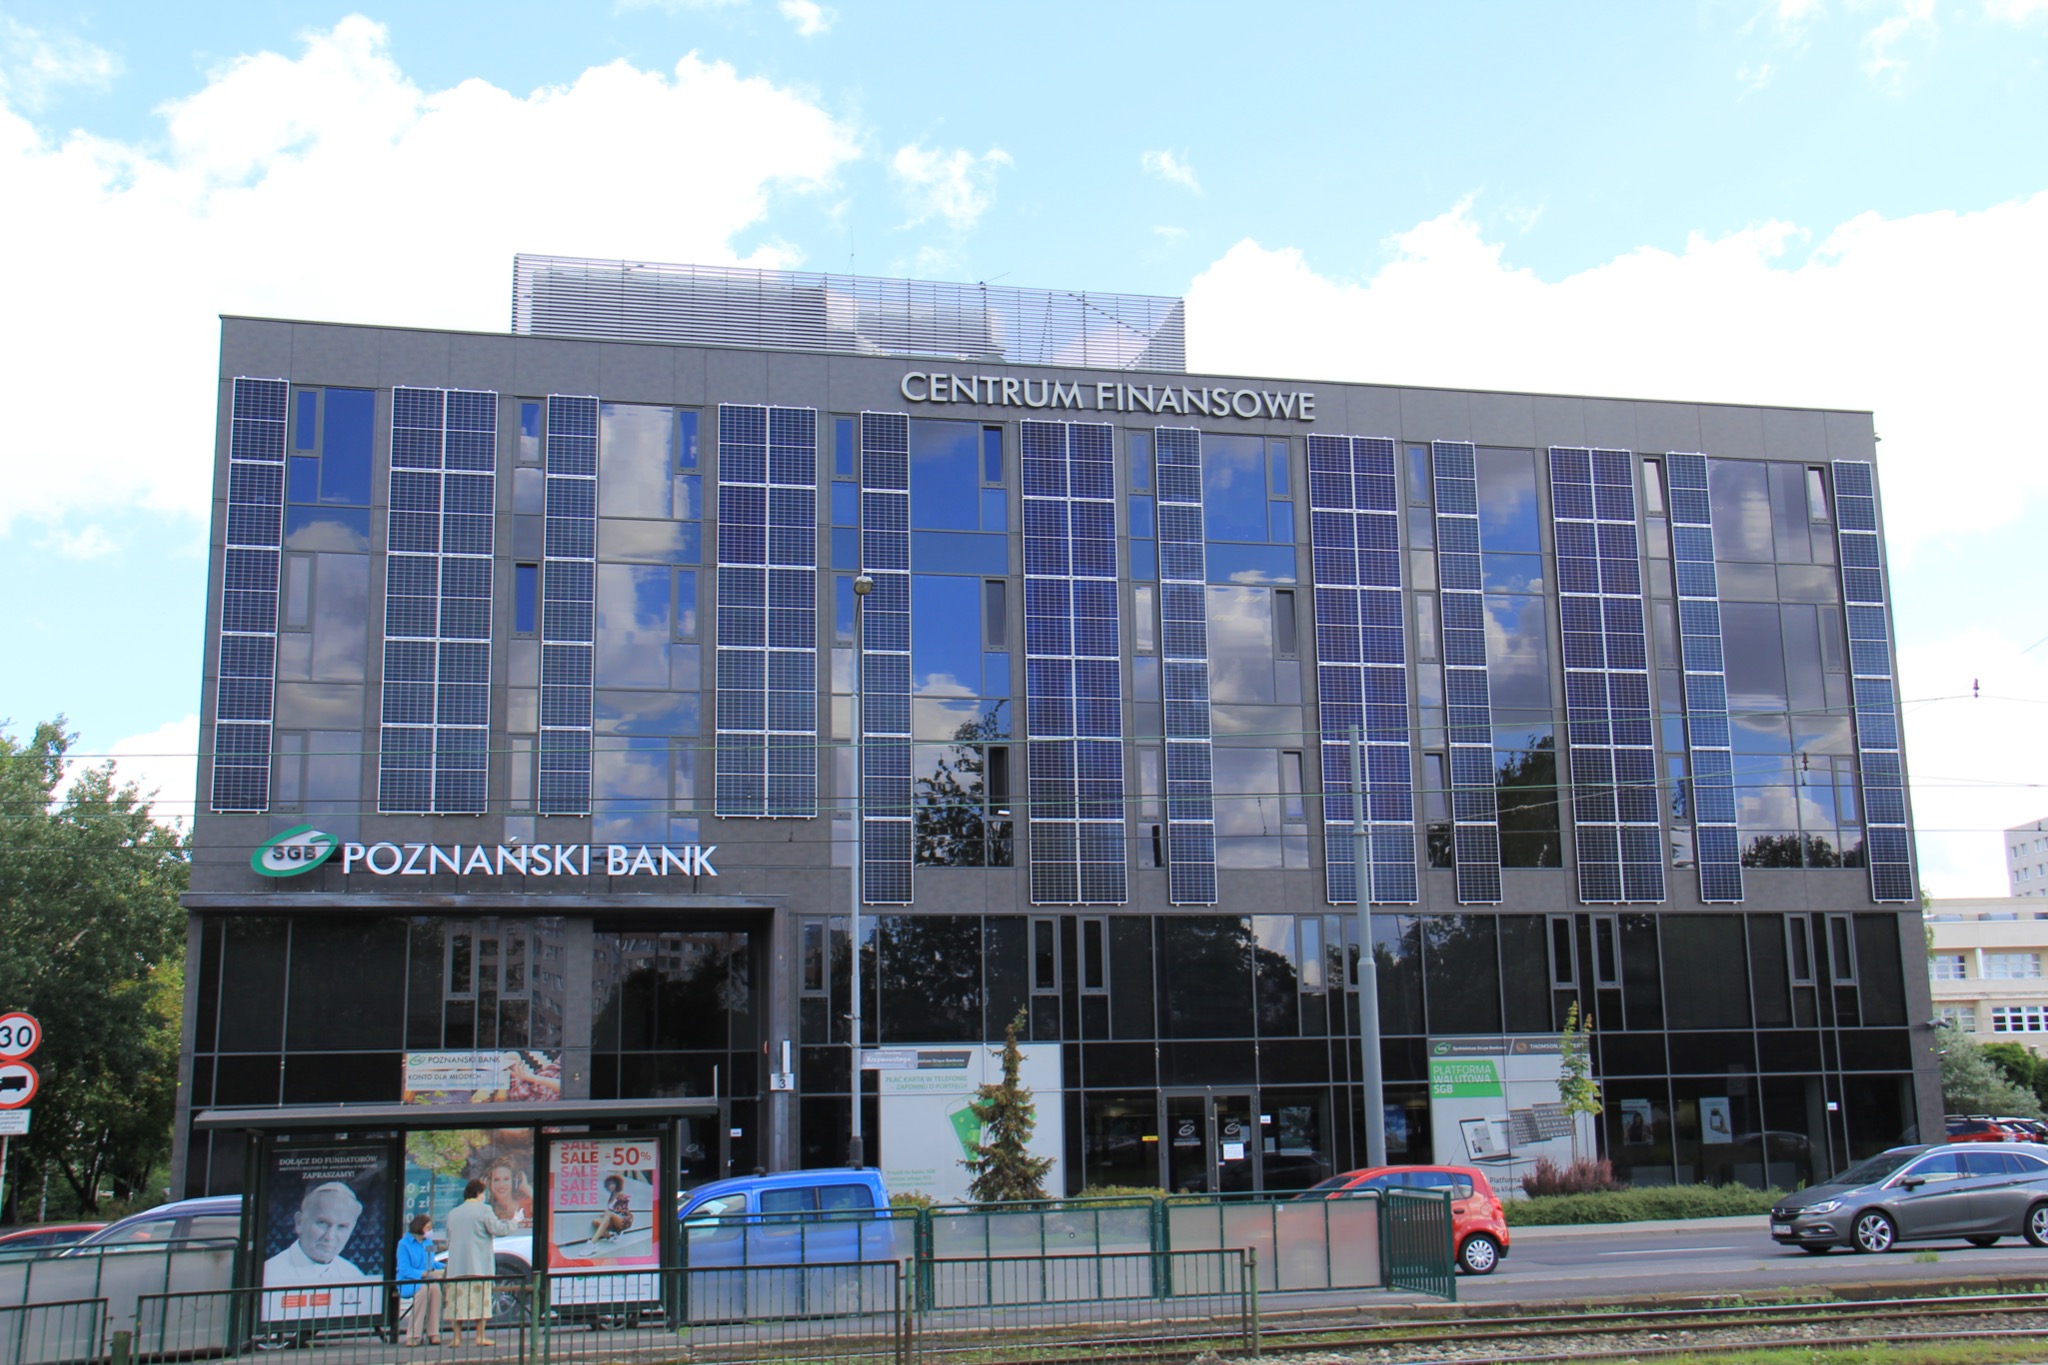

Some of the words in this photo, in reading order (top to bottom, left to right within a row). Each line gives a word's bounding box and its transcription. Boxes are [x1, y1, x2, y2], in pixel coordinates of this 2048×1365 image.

[901, 371, 1083, 408] CENTRUM
[1097, 381, 1316, 421] FINANSOWE
[272, 845, 317, 861] SGB
[607, 845, 718, 876] BANK
[0, 1026, 32, 1048] 30
[478, 1055, 500, 1063] BANK
[1433, 1065, 1491, 1075] PLATFORMA
[779, 1078, 786, 1089] 3
[1434, 1075, 1491, 1083] WALUTOWA
[1434, 1084, 1453, 1094] SGB
[561, 1141, 599, 1150] SALE
[279, 1157, 310, 1166] DOŁĄCZ
[324, 1155, 378, 1164] FUNDATORÓW
[560, 1152, 599, 1164] SALE
[605, 1147, 652, 1166] -50%
[302, 1171, 355, 1179] ZAPRASZAMY!
[560, 1165, 599, 1178] SALE
[407, 1183, 415, 1193] 0
[420, 1181, 430, 1193] zł
[560, 1179, 599, 1192] SALE
[406, 1198, 415, 1208] 0
[418, 1196, 430, 1208] zł
[560, 1193, 599, 1206] SALE
